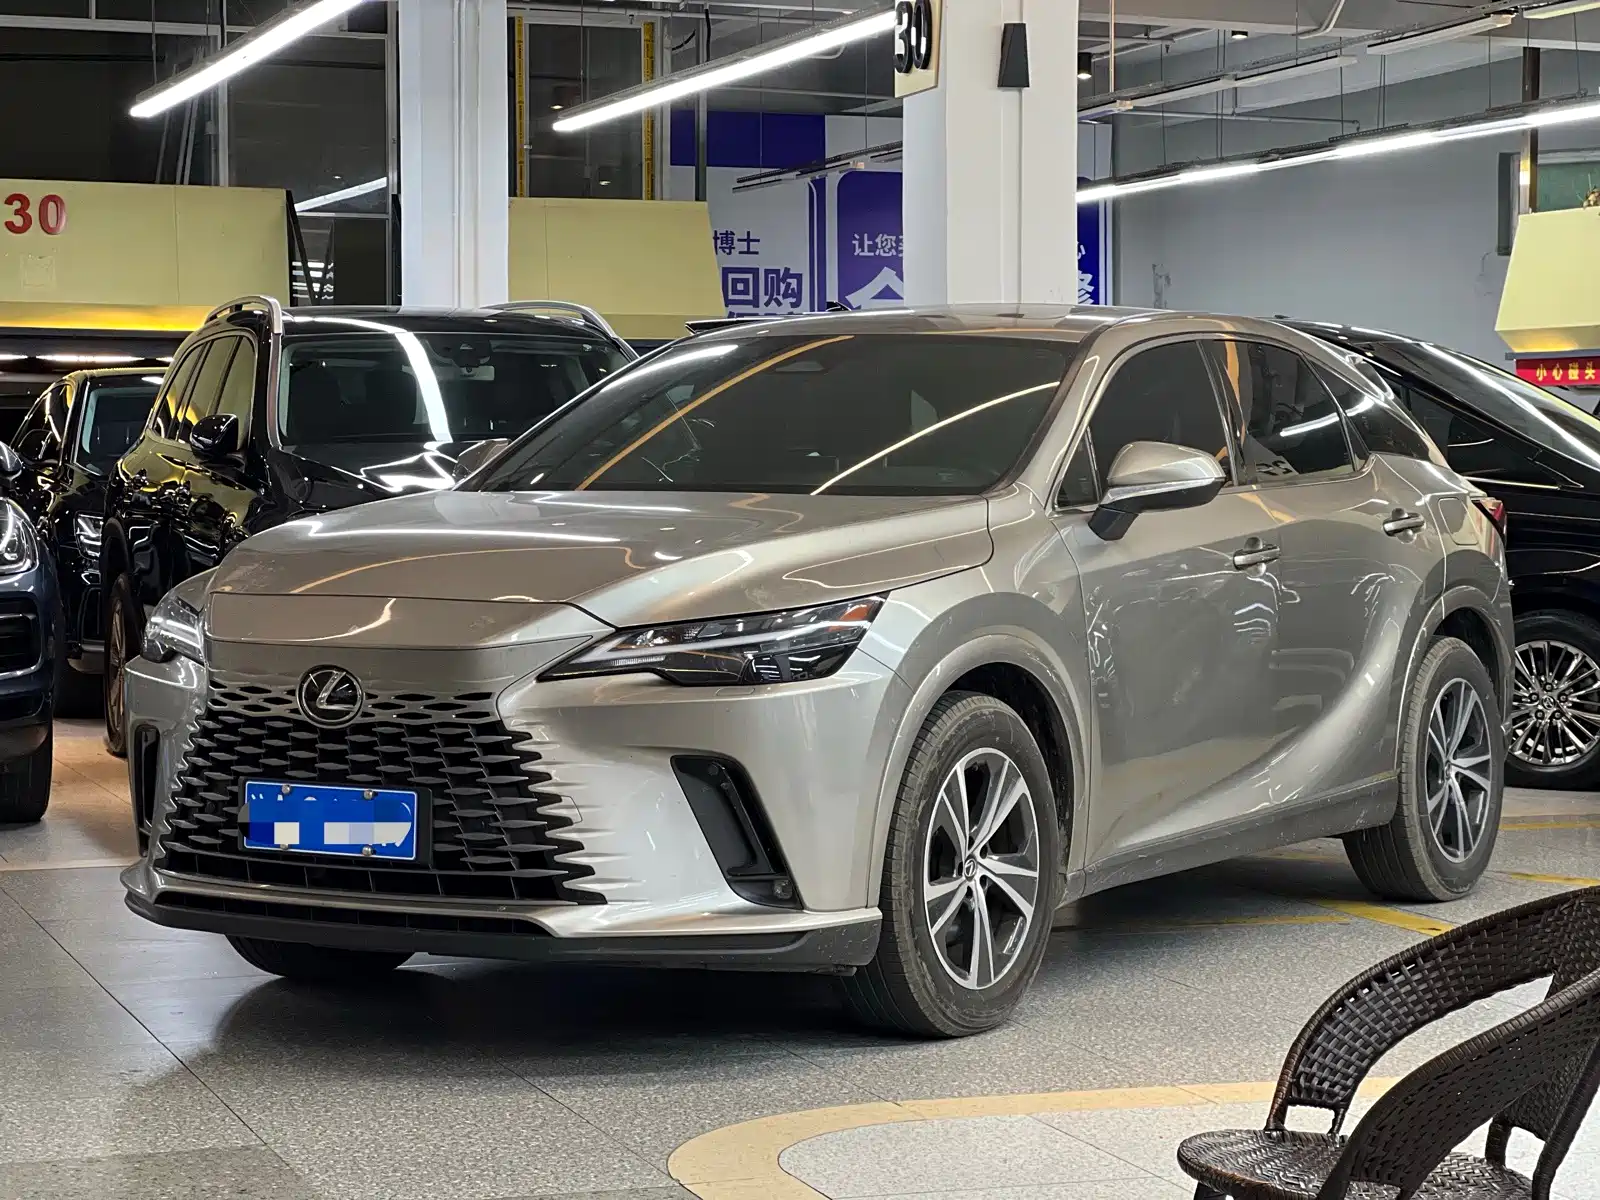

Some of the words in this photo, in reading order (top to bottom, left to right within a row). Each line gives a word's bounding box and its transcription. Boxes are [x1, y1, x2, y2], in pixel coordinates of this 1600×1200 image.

[894, 0, 932, 73] 30
[4, 193, 67, 235] 30
[713, 229, 760, 255] 博士
[852, 233, 903, 257] 让您
[721, 266, 803, 308] 回购
